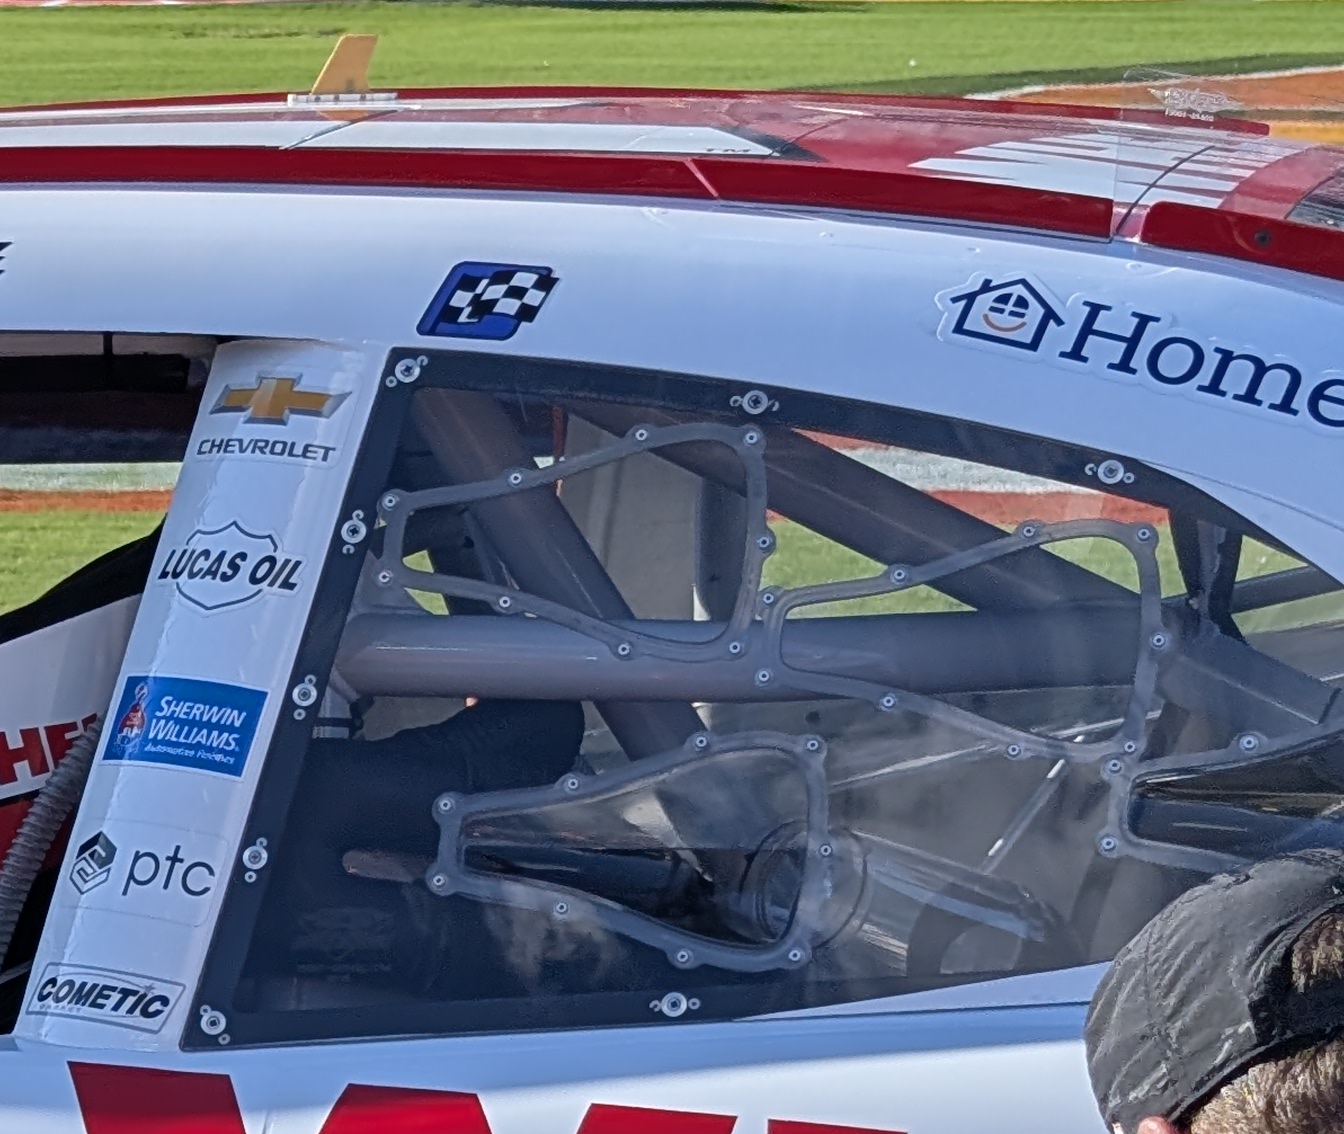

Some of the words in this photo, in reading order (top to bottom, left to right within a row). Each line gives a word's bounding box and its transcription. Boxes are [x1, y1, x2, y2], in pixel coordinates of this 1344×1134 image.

[1058, 299, 1344, 428] Home
[196, 437, 337, 462] CHEVROLET
[157, 548, 244, 583] LUCAS
[248, 555, 303, 591] OIL
[155, 695, 247, 727] SHERWIN
[148, 718, 241, 751] WILLIAMS
[121, 844, 216, 897] ptc
[37, 976, 170, 1018] COMETIC
